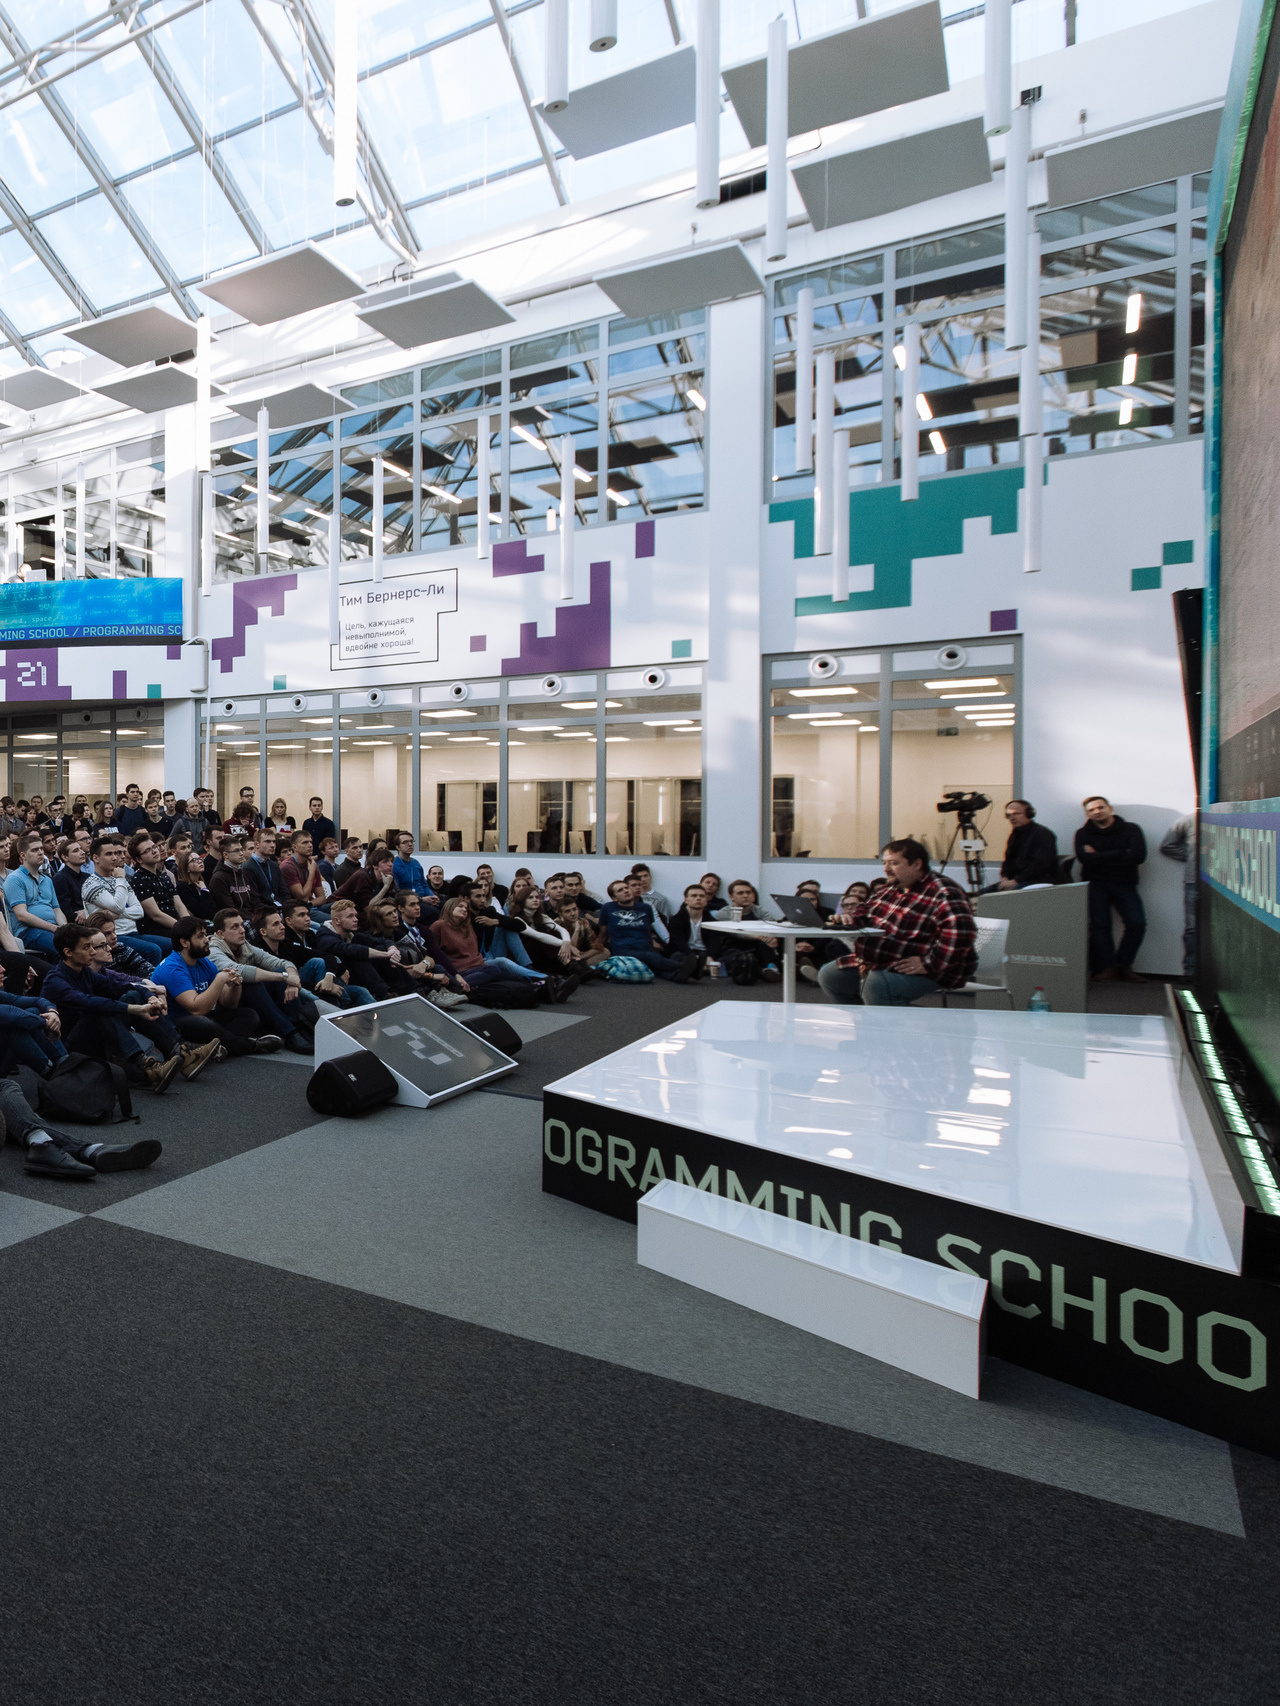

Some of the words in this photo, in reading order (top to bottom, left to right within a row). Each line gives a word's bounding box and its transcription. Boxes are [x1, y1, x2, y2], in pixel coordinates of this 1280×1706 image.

[340, 595, 362, 607] Тим
[367, 584, 444, 604] Бернерс-Ли
[345, 621, 366, 631] Цель,
[368, 616, 414, 628] кажущаяся
[28, 627, 69, 639] SCHOOL
[83, 625, 164, 636] PROGRAMMING
[345, 628, 407, 641] невыполнимой,
[345, 640, 378, 653] вдвойне
[380, 638, 414, 650] хороша!
[17, 661, 47, 687] 21
